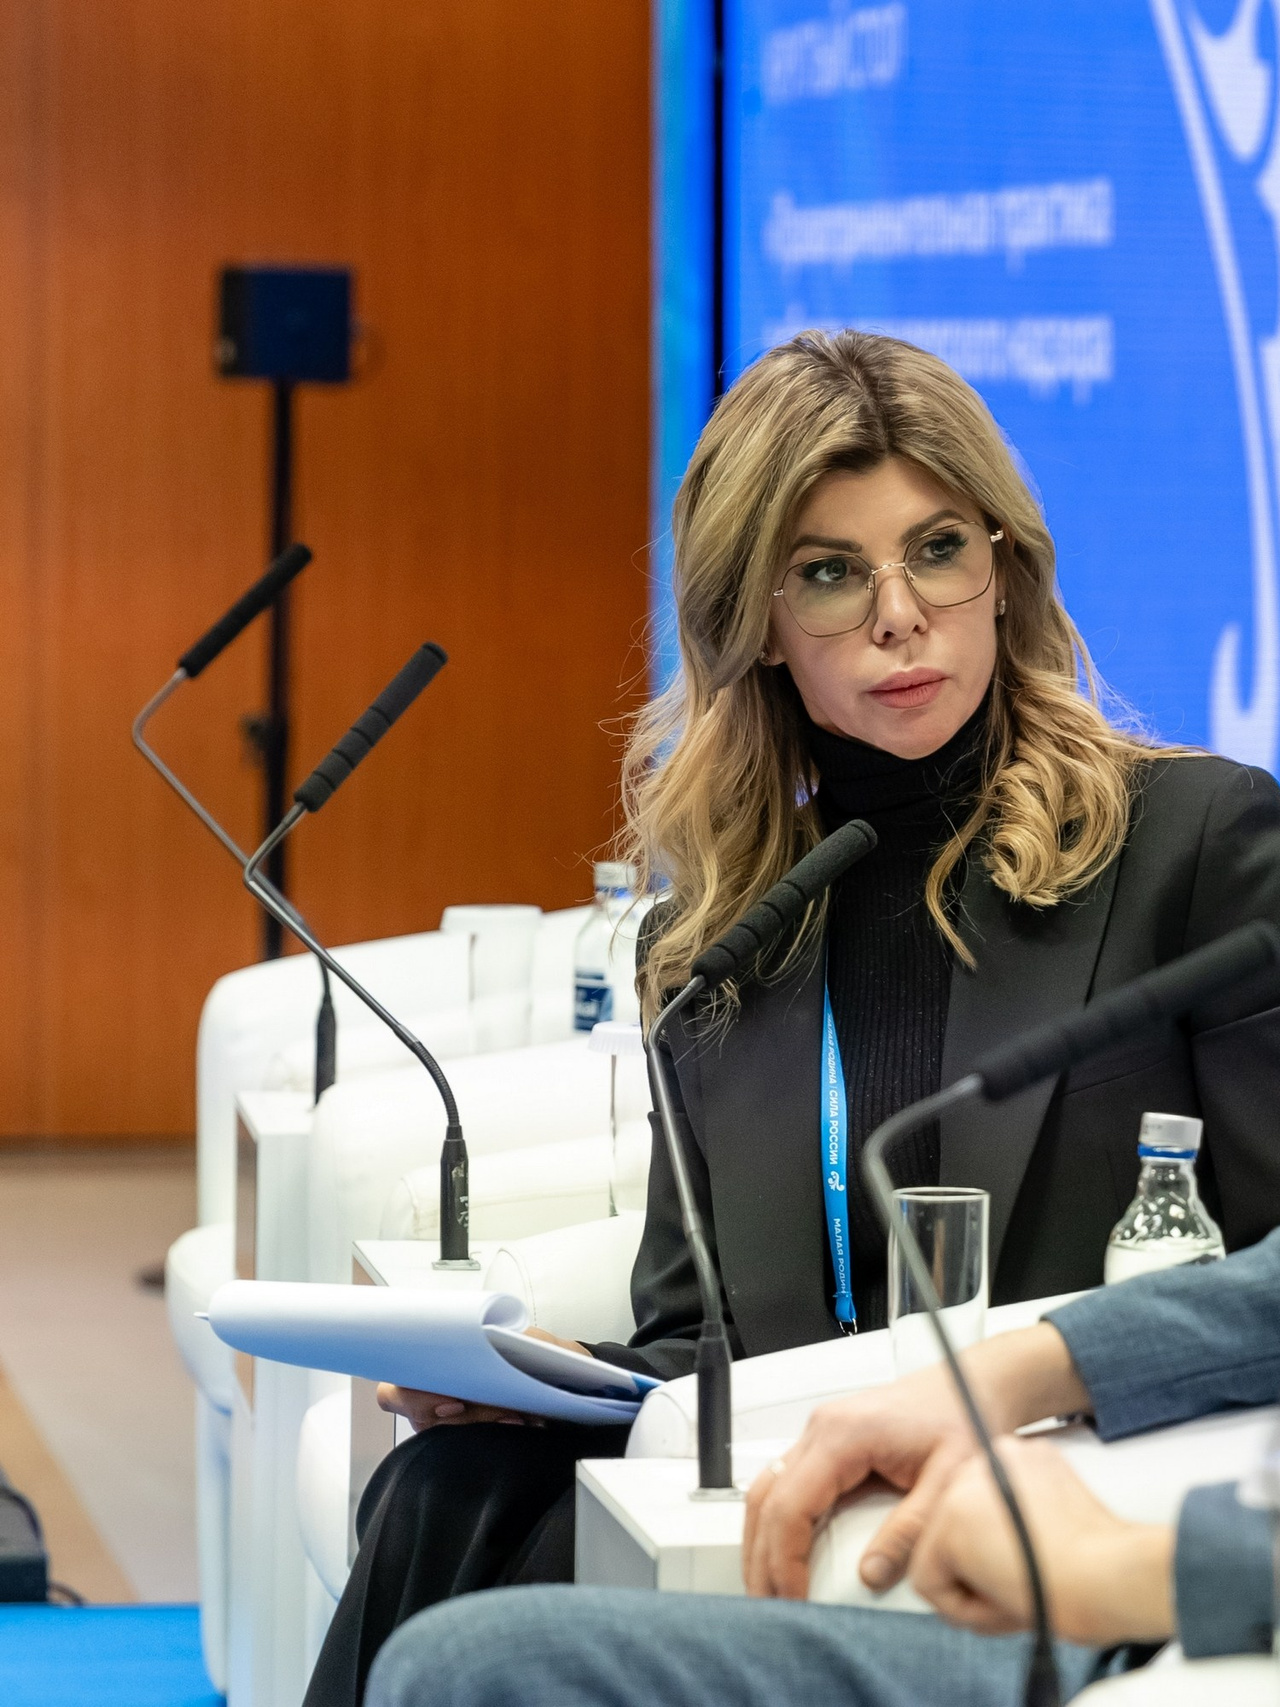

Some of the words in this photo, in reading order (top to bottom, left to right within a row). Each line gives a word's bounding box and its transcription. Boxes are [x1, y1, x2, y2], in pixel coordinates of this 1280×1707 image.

[828, 1048, 838, 1084] РОДИНА
[829, 1090, 839, 1117] СИЛА
[829, 1120, 839, 1165] РОССИИ
[833, 1218, 844, 1256] МАЛАЯ
[838, 1257, 846, 1294] РОДИН
